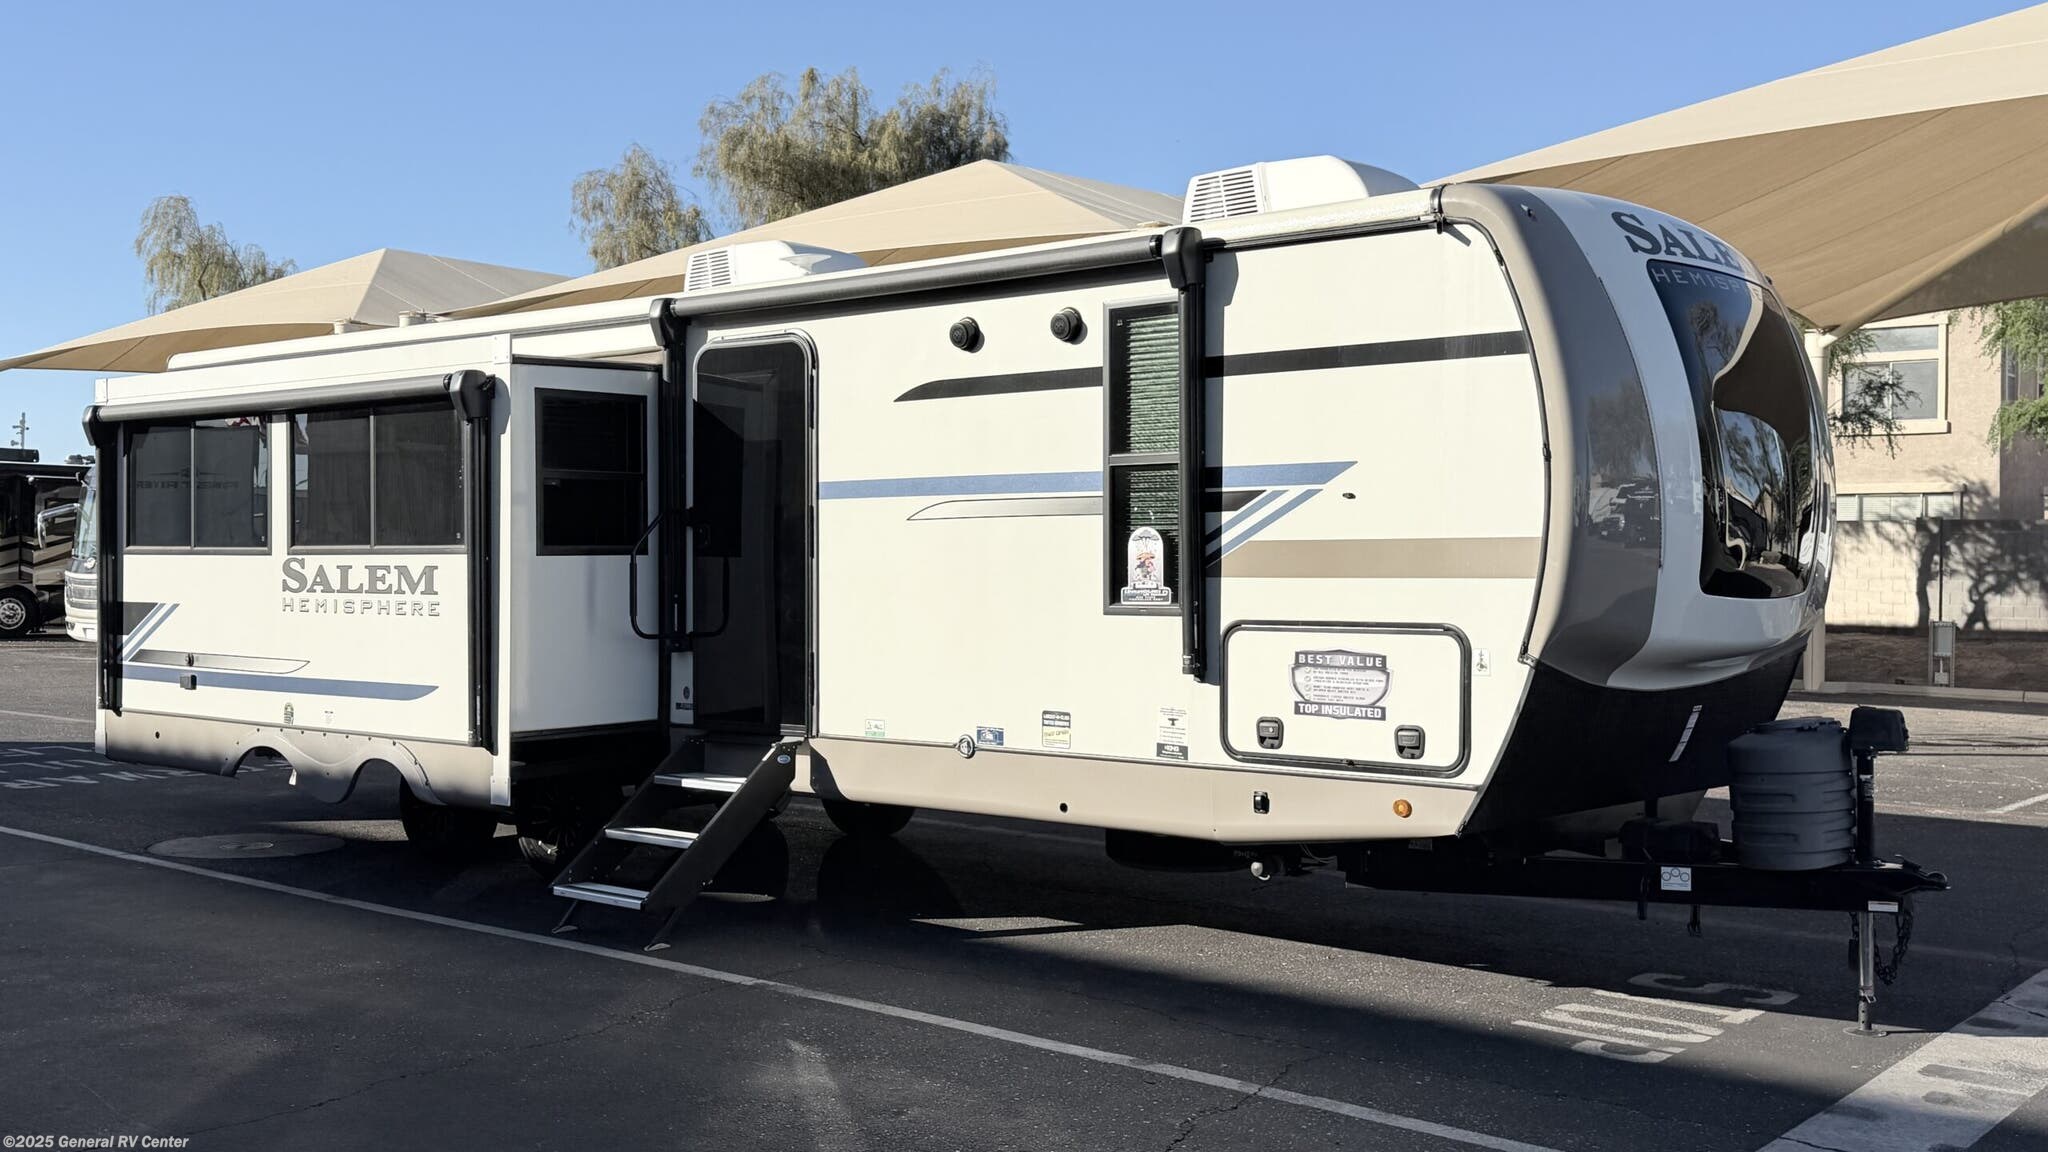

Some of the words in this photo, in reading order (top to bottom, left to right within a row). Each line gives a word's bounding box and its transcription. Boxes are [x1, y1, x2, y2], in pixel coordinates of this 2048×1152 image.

[282, 557, 438, 595] SALEM
[282, 597, 440, 617] HEMISPHERE
[1298, 654, 1331, 665] BEST
[1337, 655, 1383, 667] VALUE
[1297, 703, 1319, 714] TOP
[1321, 704, 1382, 717] INSULATED
